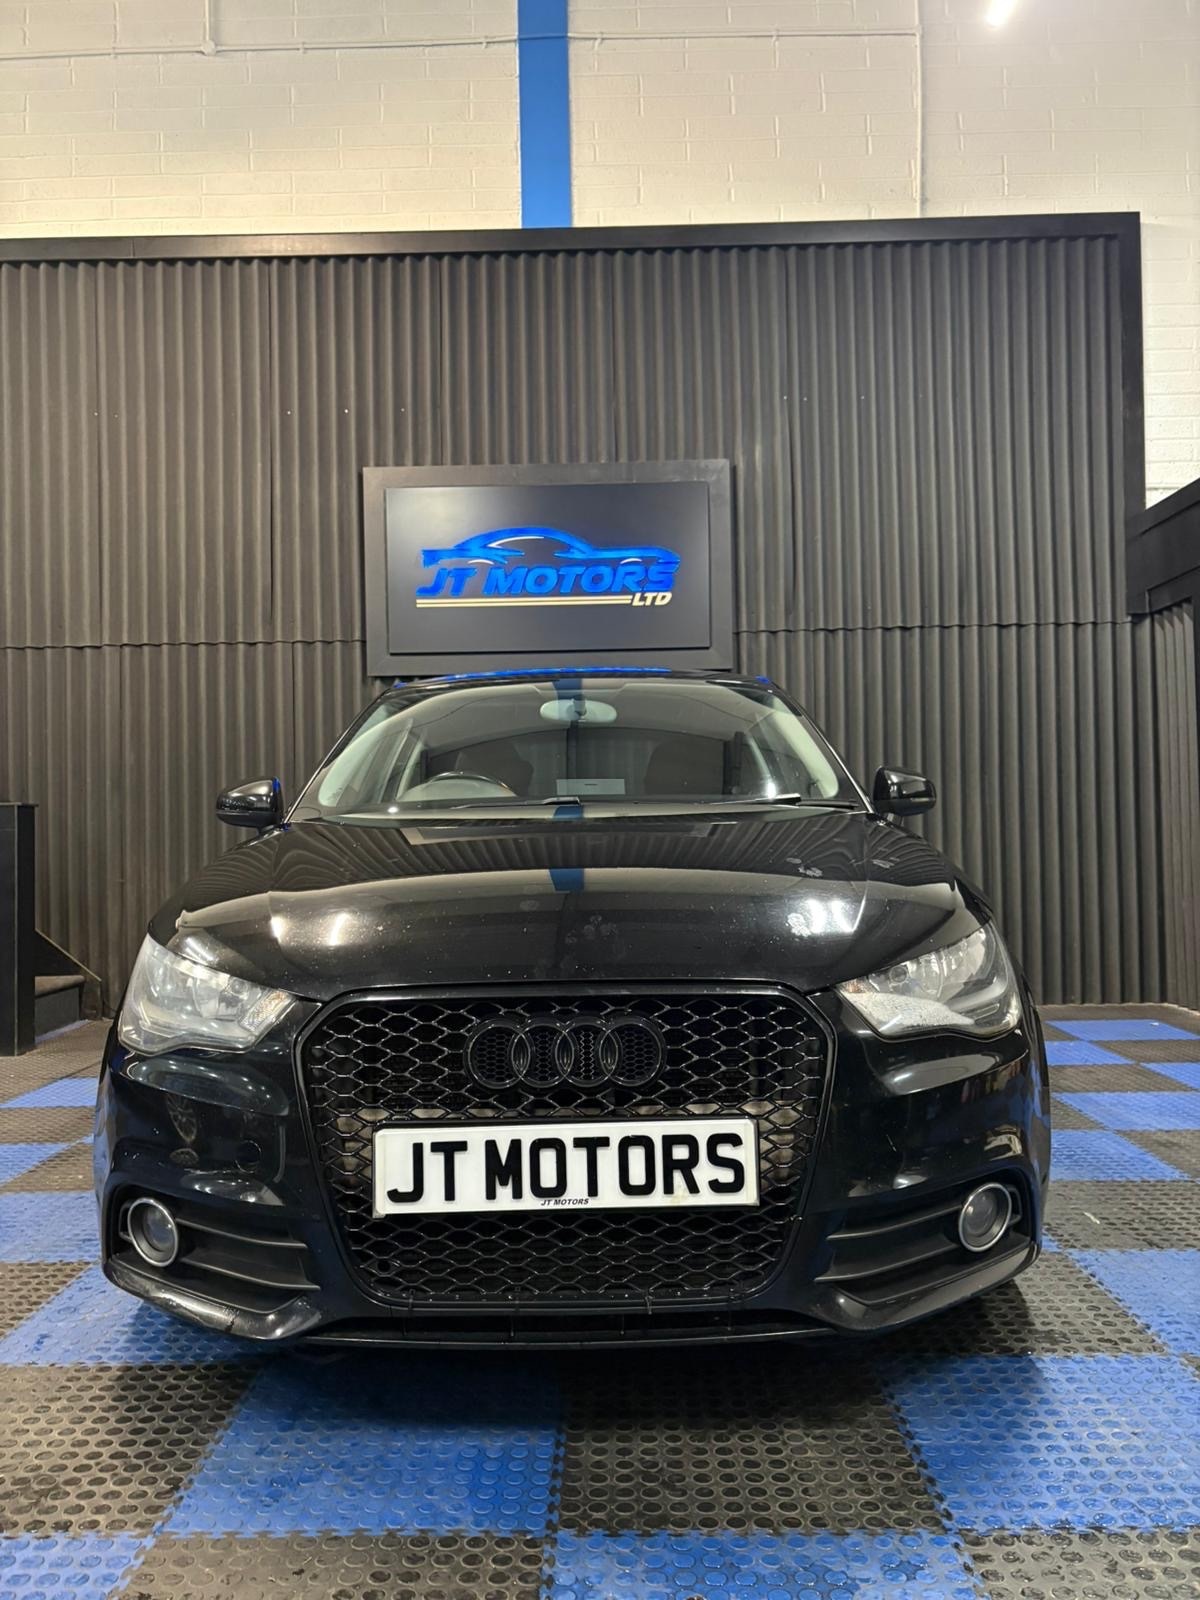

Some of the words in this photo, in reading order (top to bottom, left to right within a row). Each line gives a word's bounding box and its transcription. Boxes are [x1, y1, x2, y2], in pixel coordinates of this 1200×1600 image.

[416, 568, 477, 596] JT
[483, 564, 676, 595] MOTORS
[631, 592, 673, 607] LTD
[387, 1141, 467, 1203] JT
[485, 1133, 745, 1200] MOTORS
[553, 1198, 589, 1206] MOTORS
